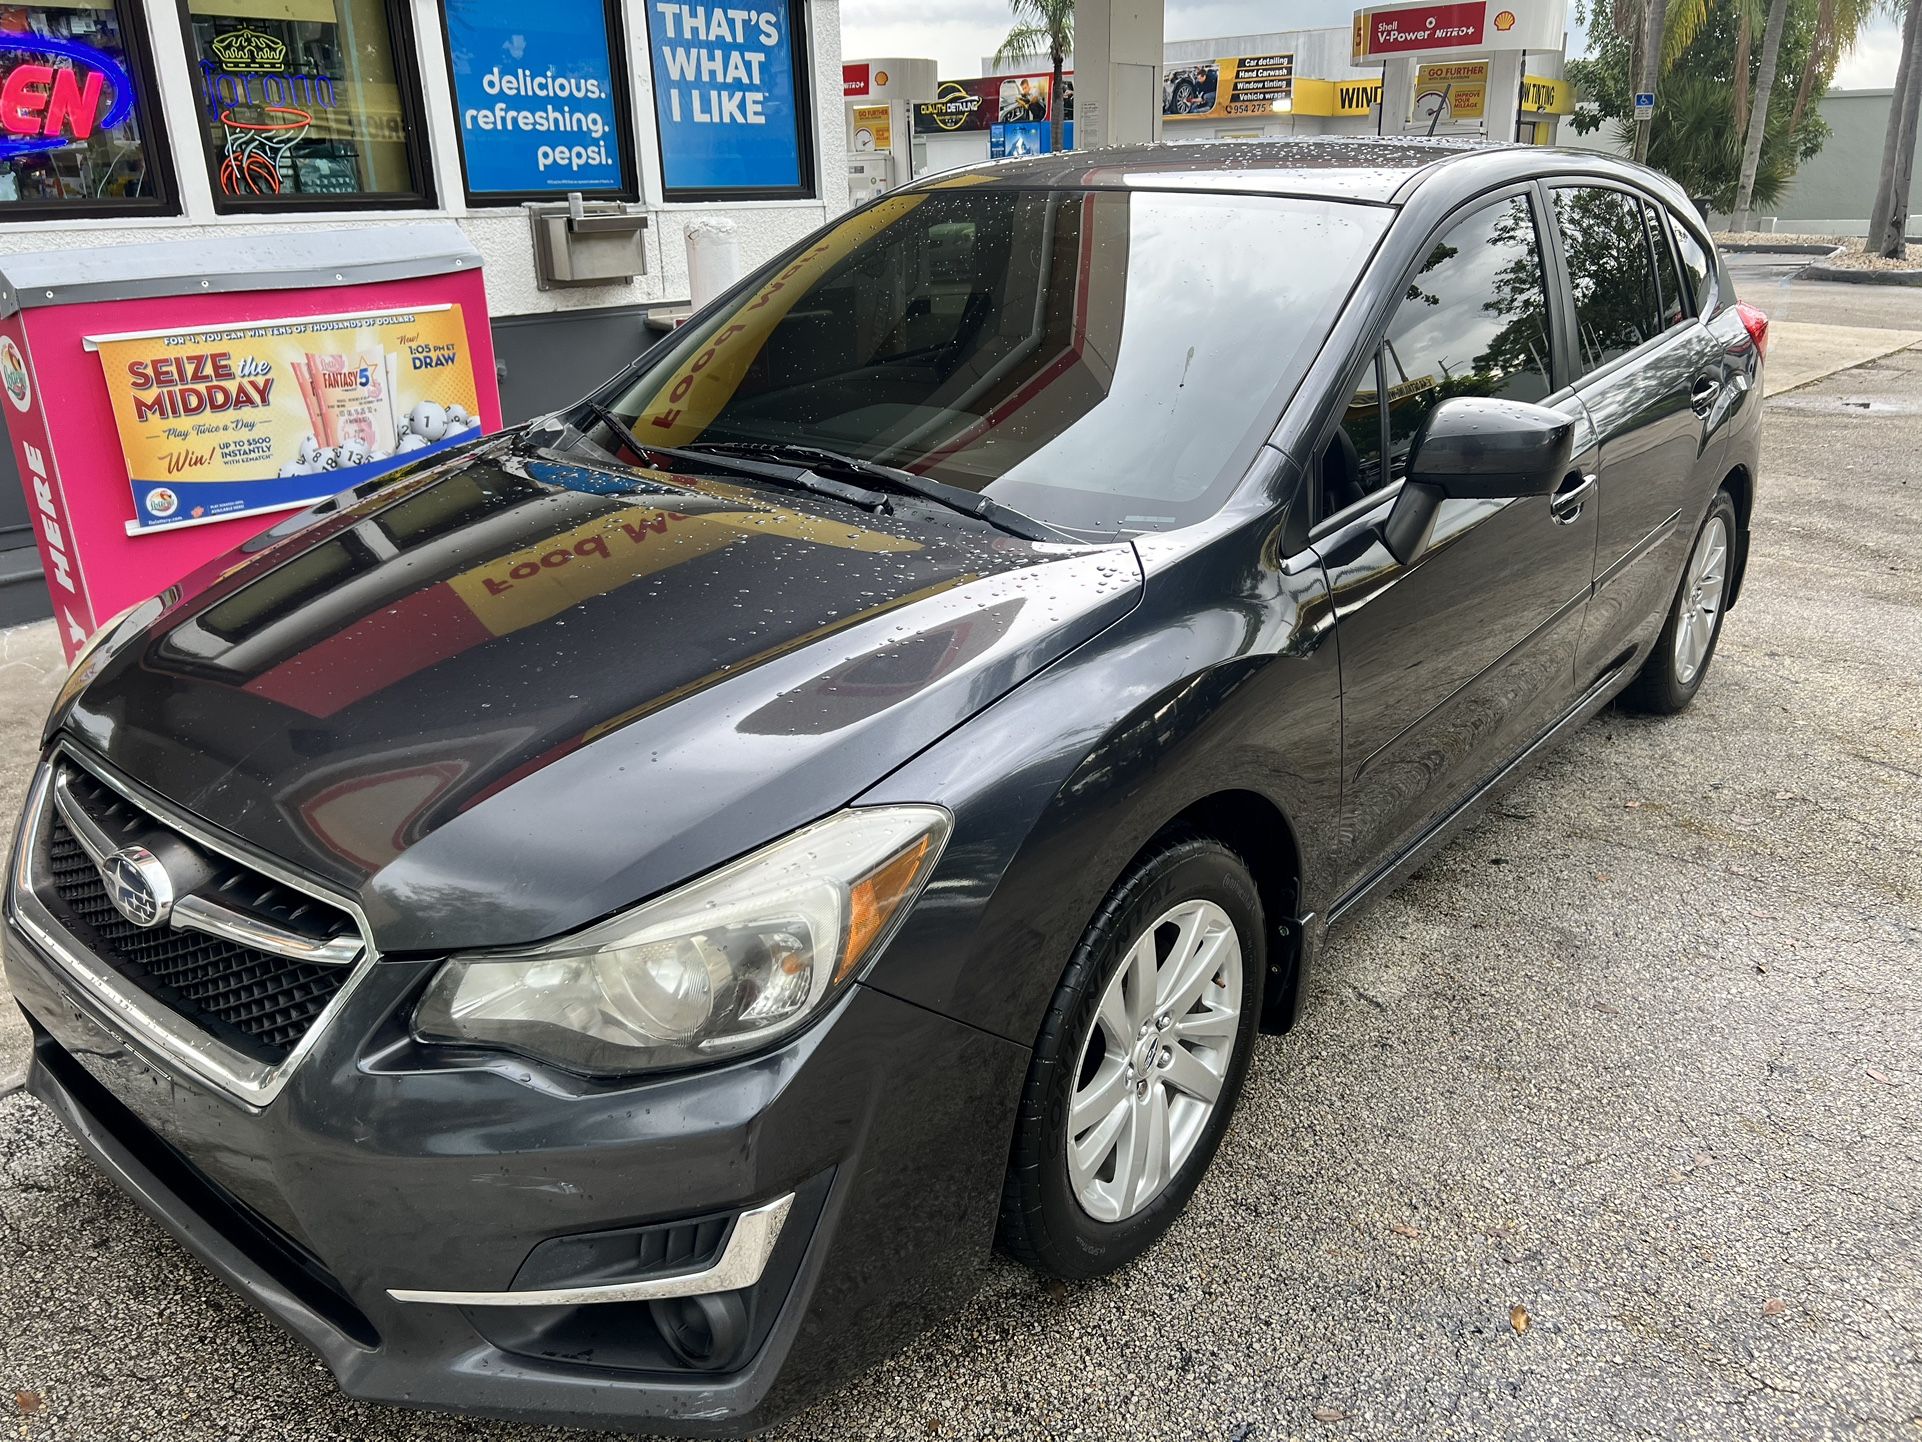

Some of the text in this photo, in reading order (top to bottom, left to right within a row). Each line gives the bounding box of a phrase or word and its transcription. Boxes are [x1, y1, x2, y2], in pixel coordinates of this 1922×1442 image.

[657, 3, 779, 46] THAT'S
[1378, 21, 1398, 31] Shell
[1378, 30, 1430, 43] V-Power
[662, 47, 765, 85] WHAT
[1258, 57, 1288, 66] detailing
[1239, 68, 1287, 78] Hand Carwash
[1428, 66, 1484, 77] GO FURTHER
[483, 67, 606, 98] delicious.
[1237, 80, 1287, 90] Window tinting
[1239, 93, 1264, 101] Vehicle
[670, 88, 766, 124] I LIKE
[921, 101, 978, 114] QUALITY DETAILING
[1234, 105, 1248, 114] 954
[1251, 104, 1266, 113] 275
[465, 103, 609, 138] refreshing.
[538, 141, 612, 171] pepsi.
[164, 336, 185, 346] FOR
[201, 333, 222, 342] YOU
[223, 331, 245, 340] CAN
[247, 329, 267, 338] WIN
[269, 326, 292, 336] TENS
[294, 325, 307, 333] OF
[310, 320, 362, 332] THOUSANDS
[364, 319, 375, 327] OF
[377, 315, 415, 325] DOLLARS
[396, 332, 419, 345] New!
[408, 344, 431, 355] 1:05
[412, 352, 456, 370] DRAW
[127, 352, 271, 390] SEIZE the
[323, 368, 370, 388] FANTASY 5
[132, 378, 274, 422] MIDDAY
[162, 427, 190, 440] Play
[192, 424, 220, 436] Twice
[230, 418, 256, 432] Day
[424, 416, 430, 428] 1
[219, 436, 271, 450] UP TO $500
[158, 446, 216, 474] Win!
[221, 445, 272, 459] INSTANTLY
[22, 440, 75, 594] HERE
